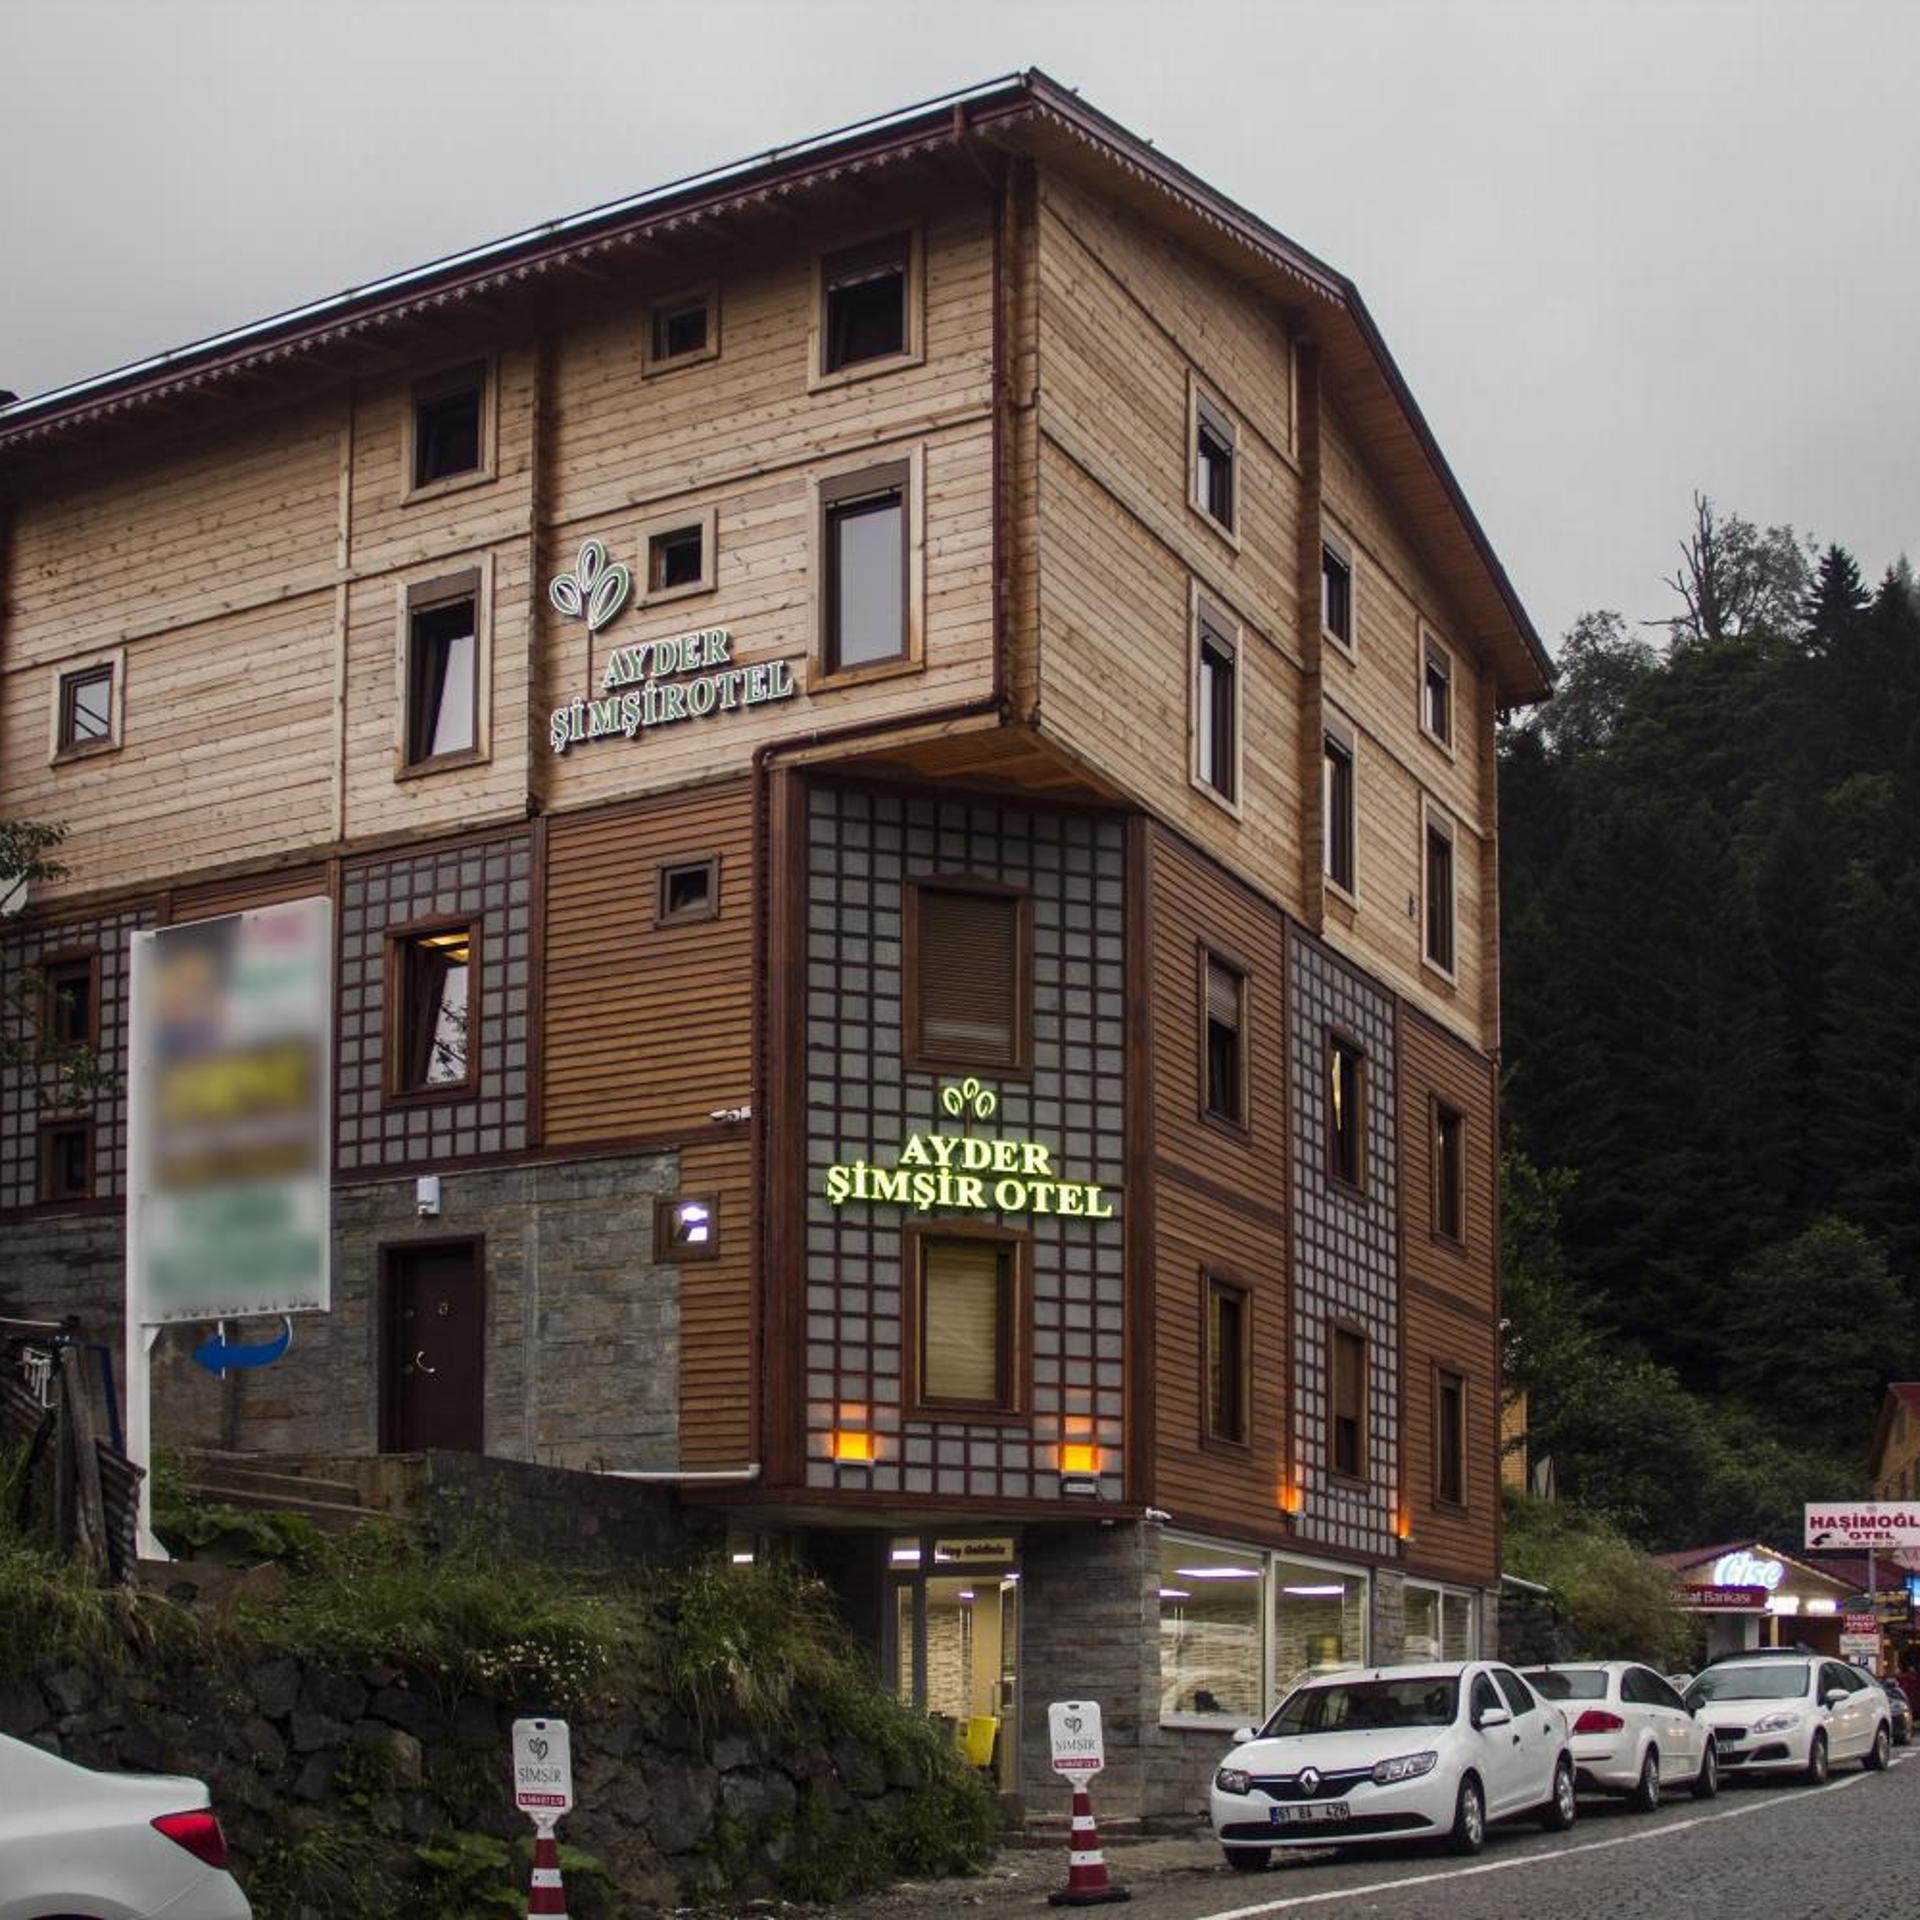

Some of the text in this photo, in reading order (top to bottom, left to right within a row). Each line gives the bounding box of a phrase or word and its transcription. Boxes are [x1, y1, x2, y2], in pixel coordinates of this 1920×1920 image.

[602, 627, 731, 689] AYDER
[900, 1134, 1052, 1175] AYDER
[826, 1160, 1113, 1217] ŞİMŞİR OTEL
[1848, 1531, 1896, 1540] OTEL
